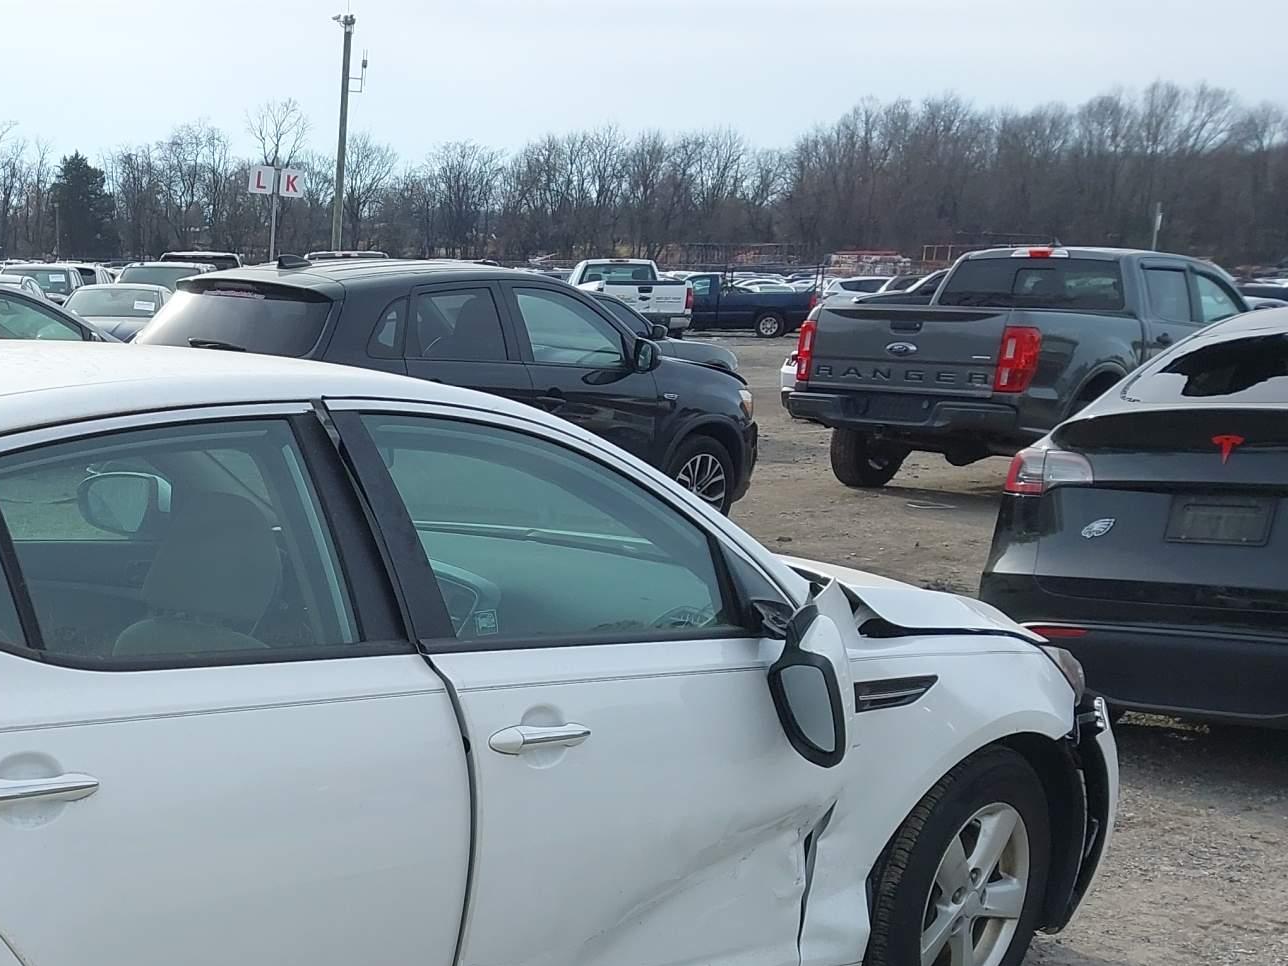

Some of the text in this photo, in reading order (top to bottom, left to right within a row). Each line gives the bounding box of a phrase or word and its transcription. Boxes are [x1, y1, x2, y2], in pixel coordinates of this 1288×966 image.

[256, 170, 267, 190] L
[285, 174, 299, 193] K
[814, 365, 990, 386] RANGER
